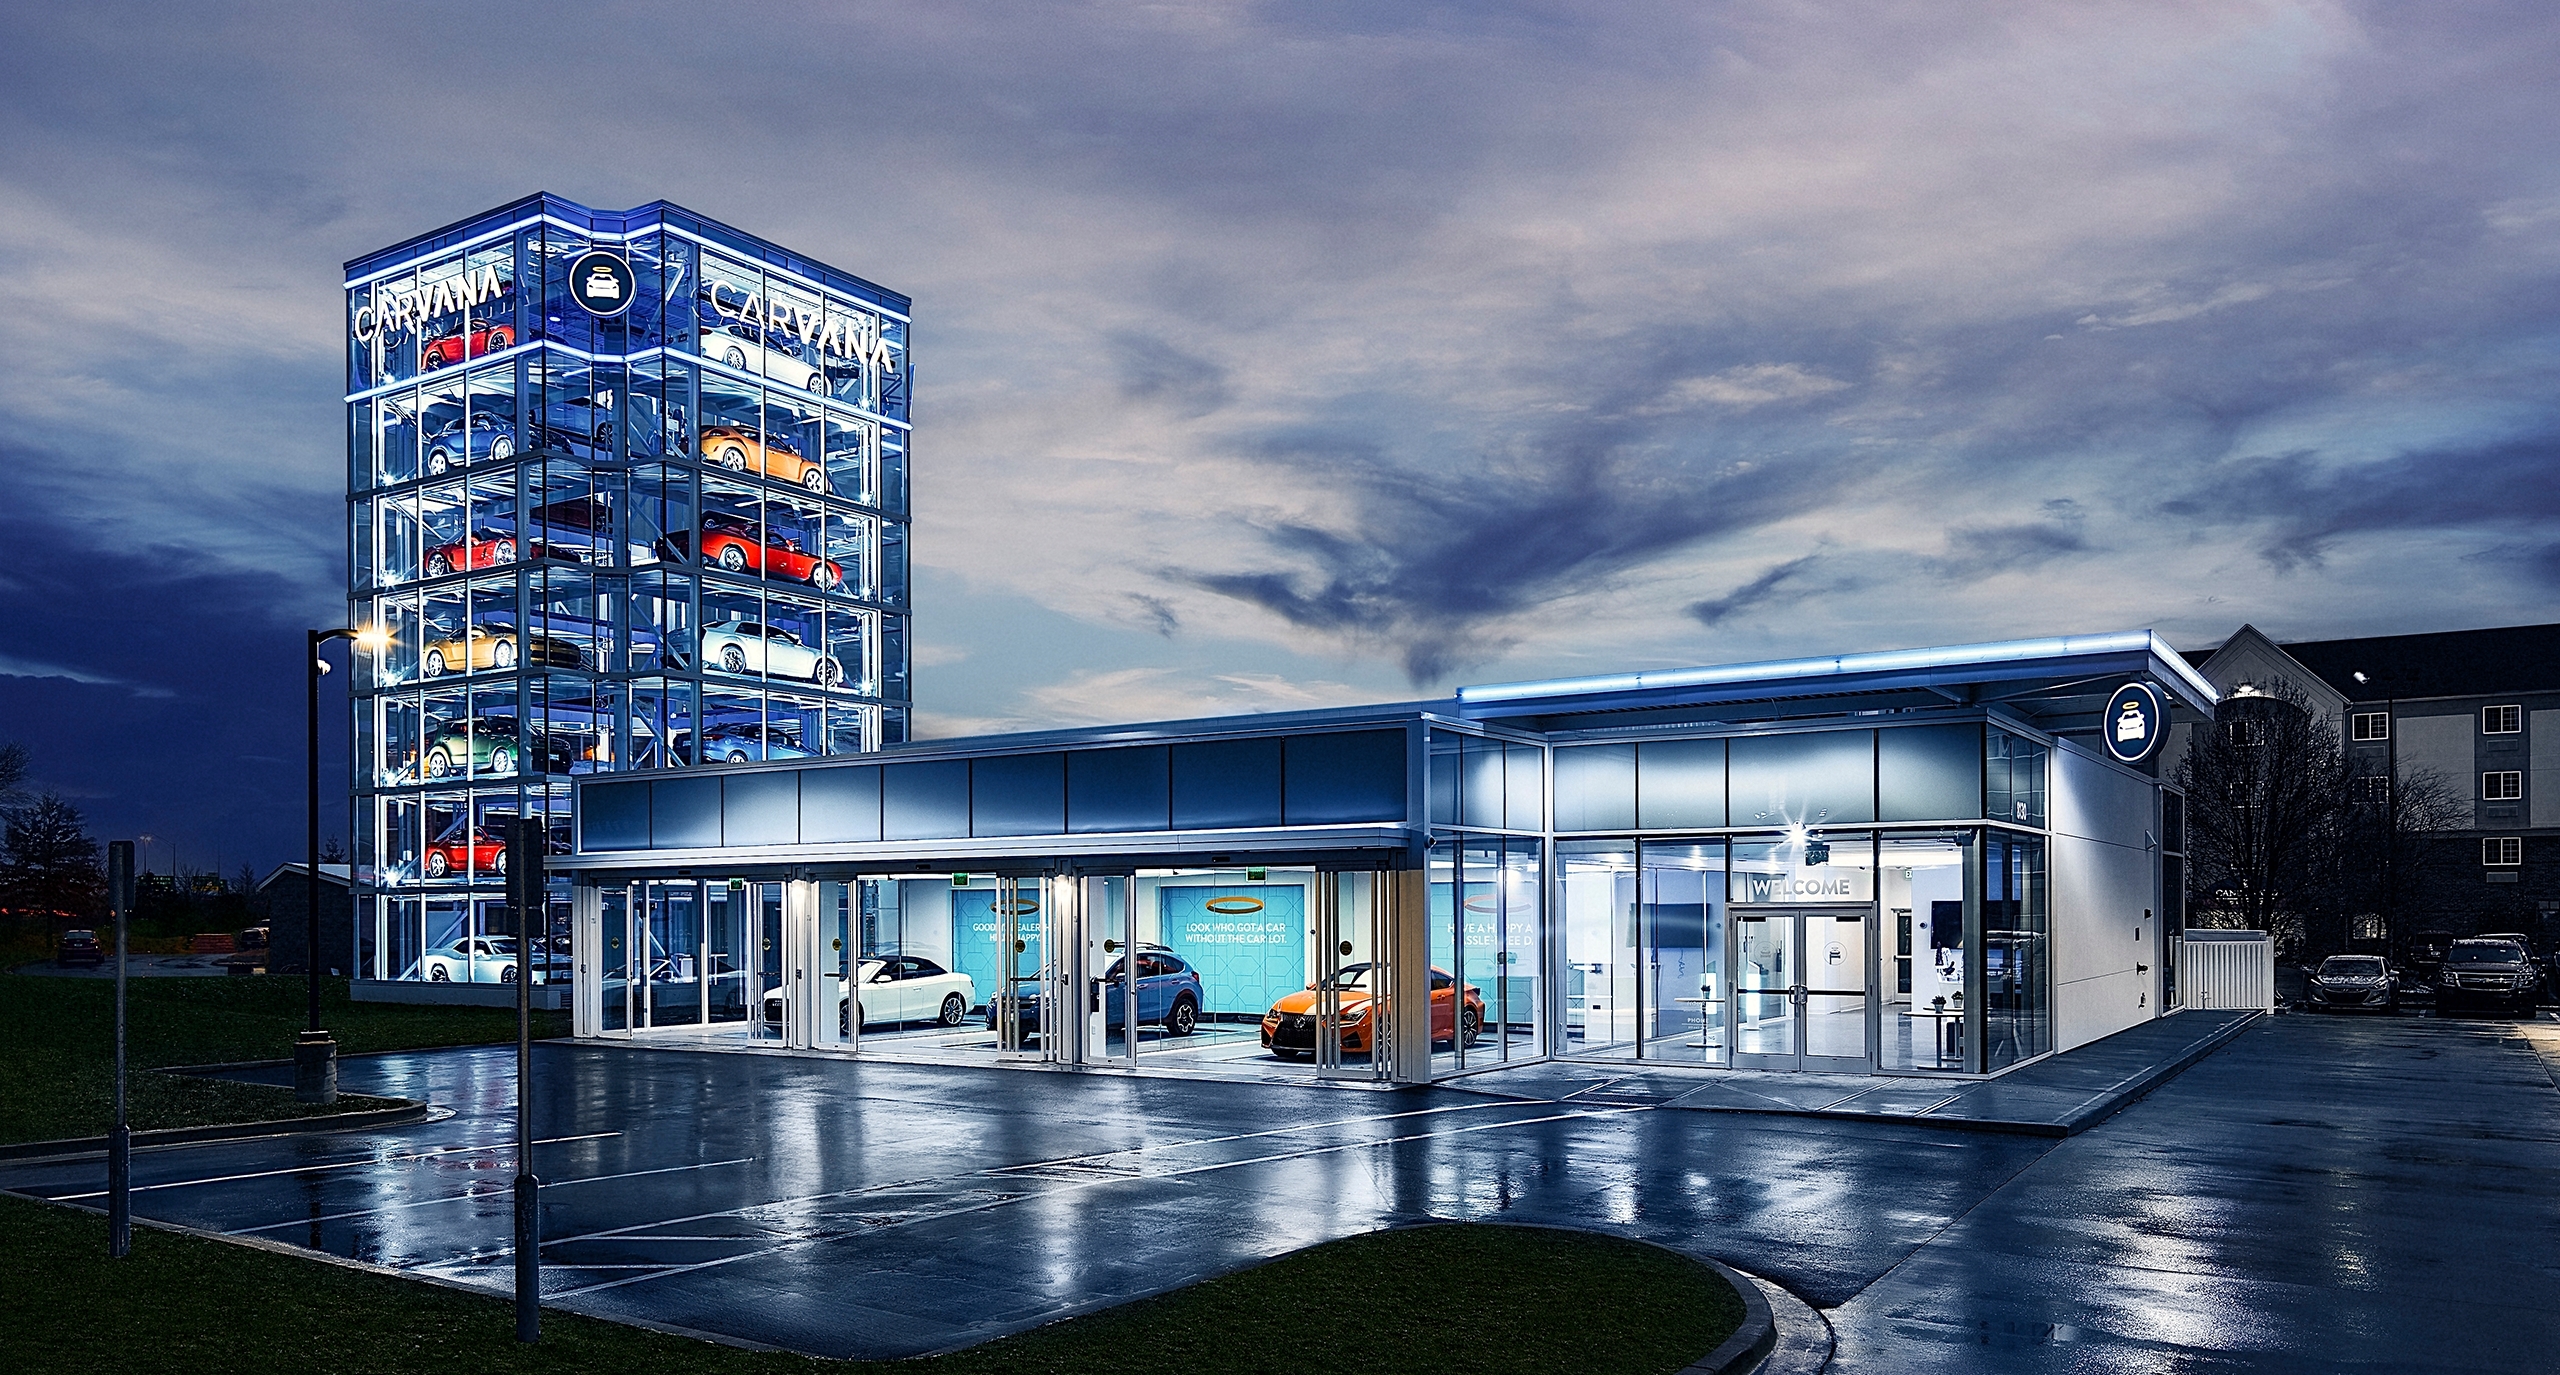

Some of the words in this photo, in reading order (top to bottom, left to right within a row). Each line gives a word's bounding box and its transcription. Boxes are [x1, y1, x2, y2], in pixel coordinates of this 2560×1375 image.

[354, 264, 503, 342] CARVANA
[709, 279, 894, 374] CARVANA
[1752, 879, 1850, 896] WELCOME
[1186, 923, 1211, 932] LOOK
[1212, 923, 1235, 932] WHO
[1237, 923, 1255, 932] GOT
[1256, 923, 1265, 932] A
[1266, 923, 1286, 932] CAR
[1447, 923, 1475, 933] HVE
[1477, 923, 1485, 933] A
[1487, 923, 1524, 933] HPY
[1185, 933, 1227, 943] WITHOUT
[1227, 933, 1246, 943] THE
[1246, 933, 1266, 943] CAR
[1268, 933, 1288, 943] LOT.
